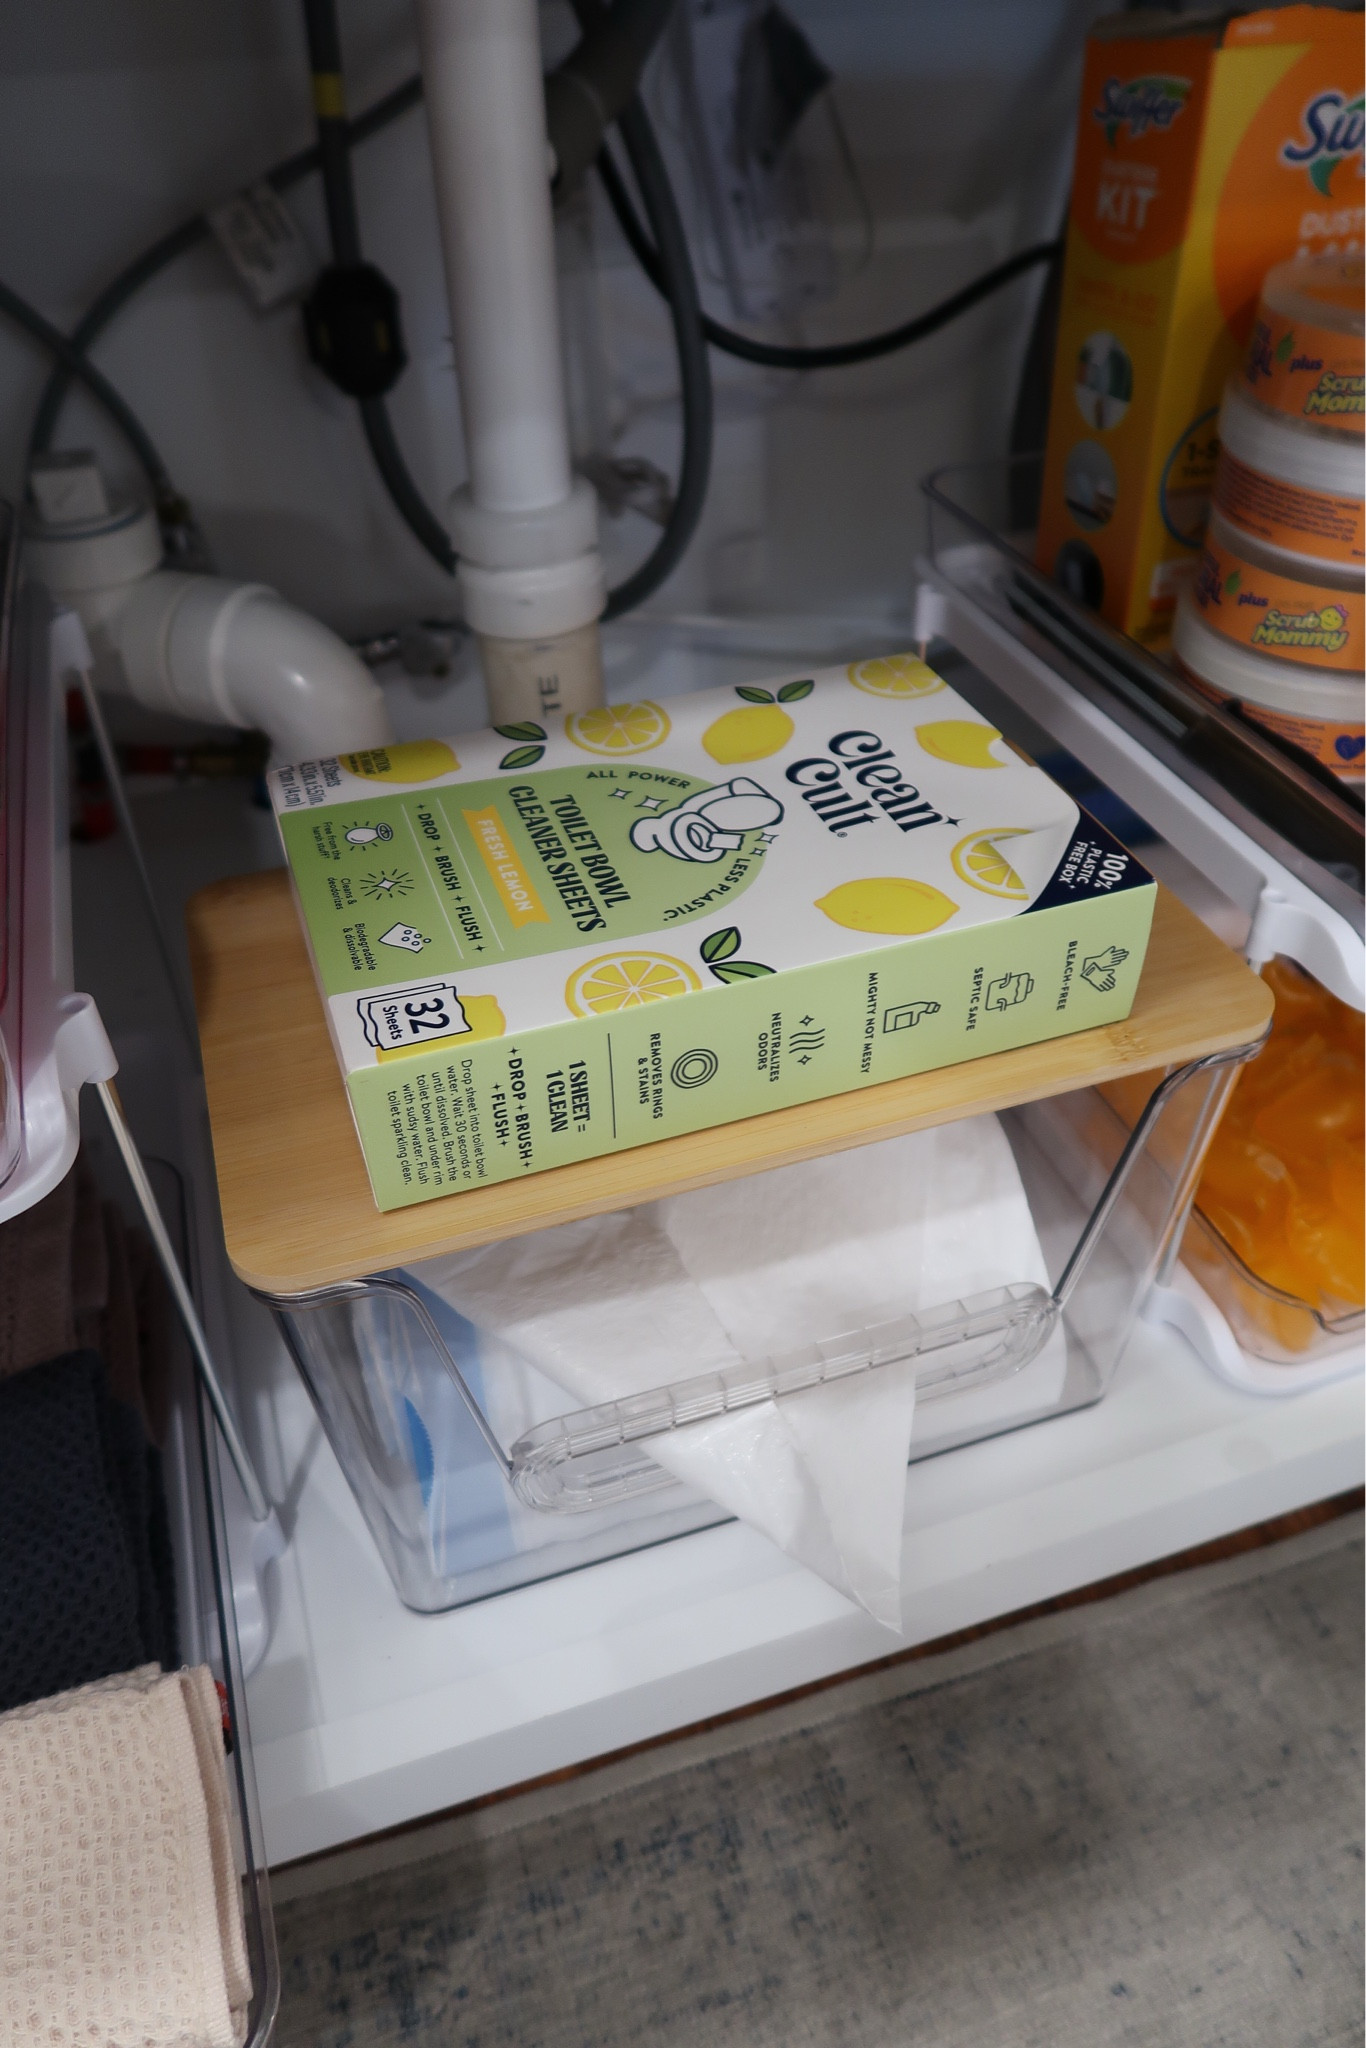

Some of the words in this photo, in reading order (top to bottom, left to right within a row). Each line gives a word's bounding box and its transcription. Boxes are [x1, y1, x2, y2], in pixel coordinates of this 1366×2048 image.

[1238, 592, 1269, 607] plus
[1264, 609, 1321, 630] Scrub
[1252, 624, 1349, 653] Mommy
[322, 765, 342, 788] Sheets
[586, 770, 618, 779] ALL
[628, 770, 691, 789] POWER
[828, 730, 943, 832] Clean
[312, 826, 324, 843] harsh
[323, 821, 333, 835] Free
[327, 834, 338, 850] from
[332, 849, 341, 861] the
[549, 794, 603, 851] TOILET
[580, 853, 632, 909] BOWL
[1068, 841, 1088, 863] FREE
[477, 819, 509, 861] FRESH
[498, 864, 534, 912] LEMON
[508, 785, 568, 862] CLEANER
[547, 862, 607, 932] SHEETS
[724, 857, 752, 884] LESS
[1076, 848, 1102, 884] PLASTIC
[1093, 853, 1129, 890] 100%
[418, 812, 441, 841] DROP
[434, 855, 462, 891] BRUSH
[455, 905, 483, 941] FLUSH
[1058, 863, 1078, 883] BOX
[327, 877, 344, 910] deodorizes
[341, 878, 352, 900] Cleans
[344, 934, 363, 971] dissolvable
[355, 922, 378, 971] Biodegradable
[970, 967, 984, 1004] SEPTIC
[1056, 940, 1078, 1011] BLEACH-FREE
[866, 972, 879, 1015] MIGHTY
[383, 1005, 402, 1041] Sheets
[404, 997, 451, 1034] 32
[864, 1018, 875, 1039] NOT
[966, 1006, 978, 1031] SAFE
[650, 1032, 663, 1086] REMOVES
[758, 1033, 769, 1071] ODORS
[769, 1012, 782, 1083] NEUTRALIZES
[860, 1042, 873, 1073] MESSY
[461, 1059, 473, 1085] Drop
[546, 1069, 564, 1079] 1
[568, 1059, 587, 1069] 1
[637, 1057, 648, 1066] &
[416, 1074, 430, 1102] toilet
[431, 1072, 444, 1097] until
[447, 1065, 459, 1096] water.
[508, 1057, 527, 1101] DROP
[638, 1067, 649, 1105] STAINS
[387, 1090, 401, 1117] toilet
[402, 1083, 416, 1103] with
[465, 1087, 478, 1112] sheet
[569, 1070, 591, 1122] SHEET
[652, 1087, 663, 1120] RINGS
[406, 1103, 418, 1132] sudsy
[421, 1101, 434, 1126] bowl
[436, 1096, 451, 1140] dissolved.
[452, 1097, 464, 1118] Wait
[491, 1092, 510, 1139] FLUSH
[547, 1081, 569, 1133] CLEAN
[425, 1126, 436, 1144] and
[456, 1120, 467, 1133] 30
[470, 1113, 479, 1132] into
[392, 1117, 407, 1159] sparkling
[411, 1132, 424, 1161] water.
[472, 1133, 484, 1159] toilet
[515, 1113, 533, 1160] BRUSH
[429, 1144, 440, 1171] under
[443, 1140, 455, 1166] Brush
[458, 1134, 472, 1170] seconds
[401, 1158, 412, 1186] clean.
[416, 1159, 430, 1185] Flush
[433, 1171, 443, 1186] rim
[448, 1166, 457, 1182] the
[464, 1170, 472, 1180] or
[476, 1158, 488, 1178] bowl
